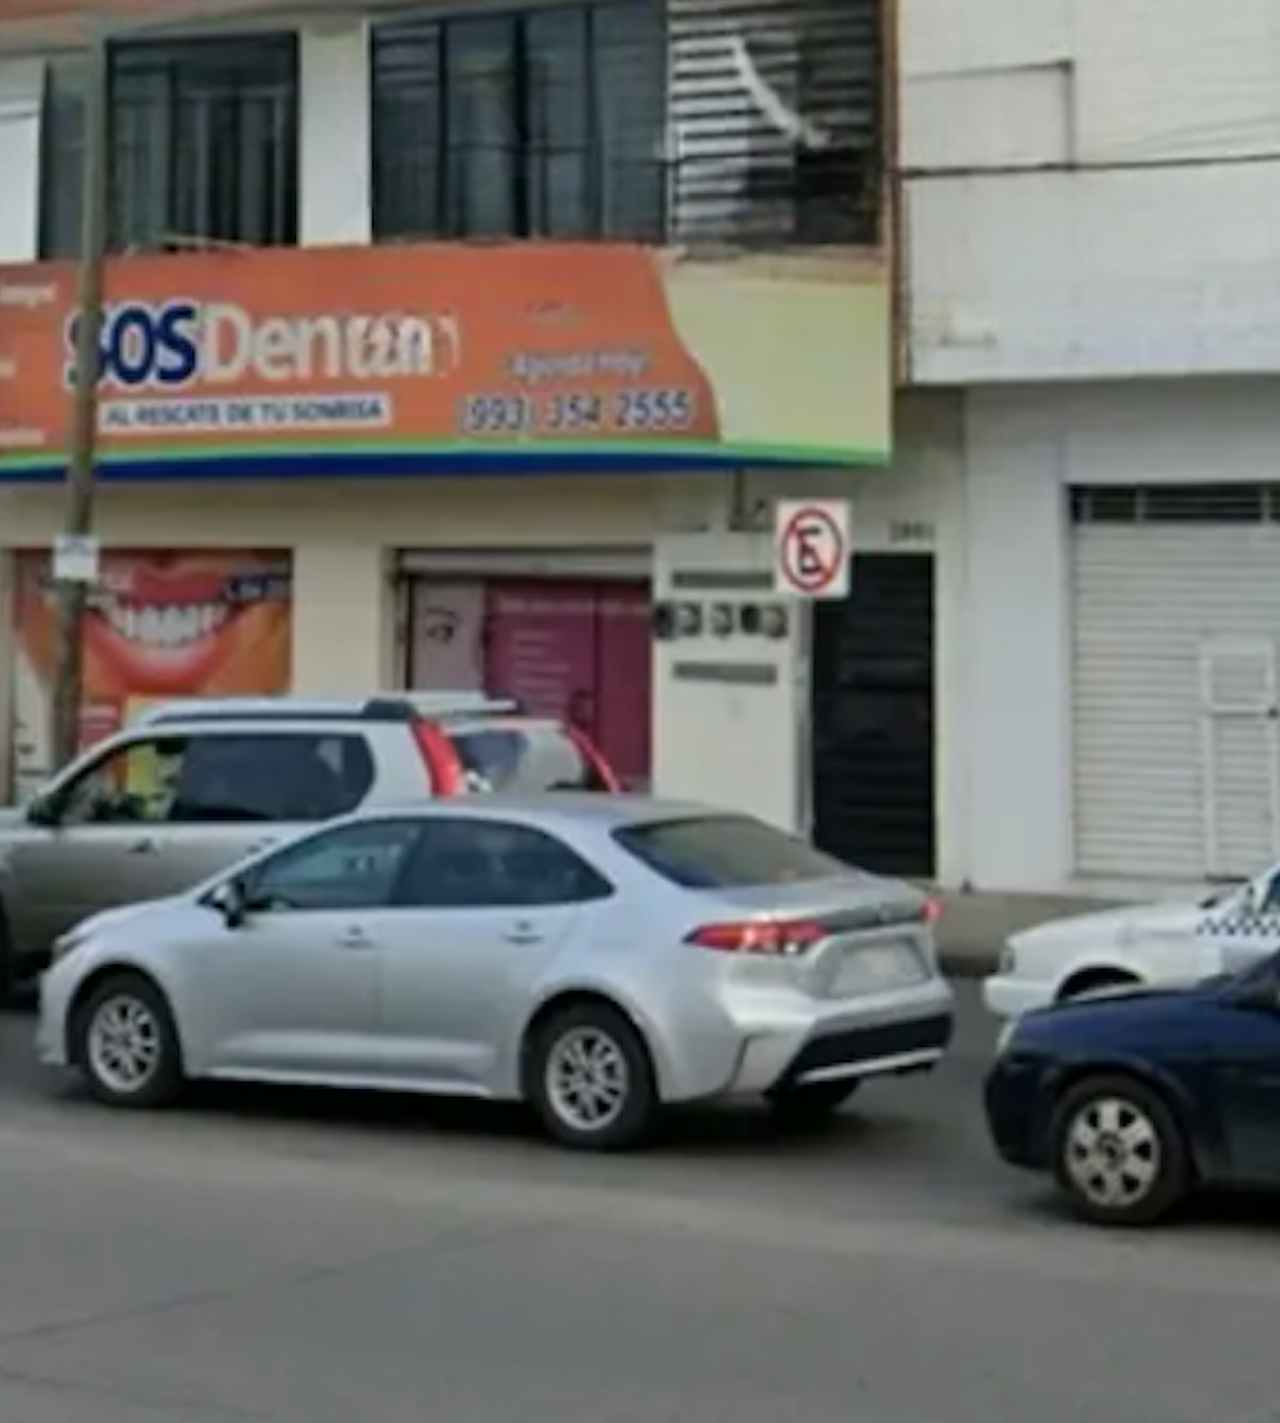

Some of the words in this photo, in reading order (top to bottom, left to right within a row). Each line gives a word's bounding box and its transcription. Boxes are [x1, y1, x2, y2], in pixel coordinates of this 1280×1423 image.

[106, 403, 129, 425] AL
[135, 401, 220, 425] RESCATE
[227, 401, 254, 422] DE
[260, 400, 288, 421] TU
[292, 398, 384, 421] SONRISA
[545, 392, 603, 429] 354
[614, 389, 692, 428] 2555
